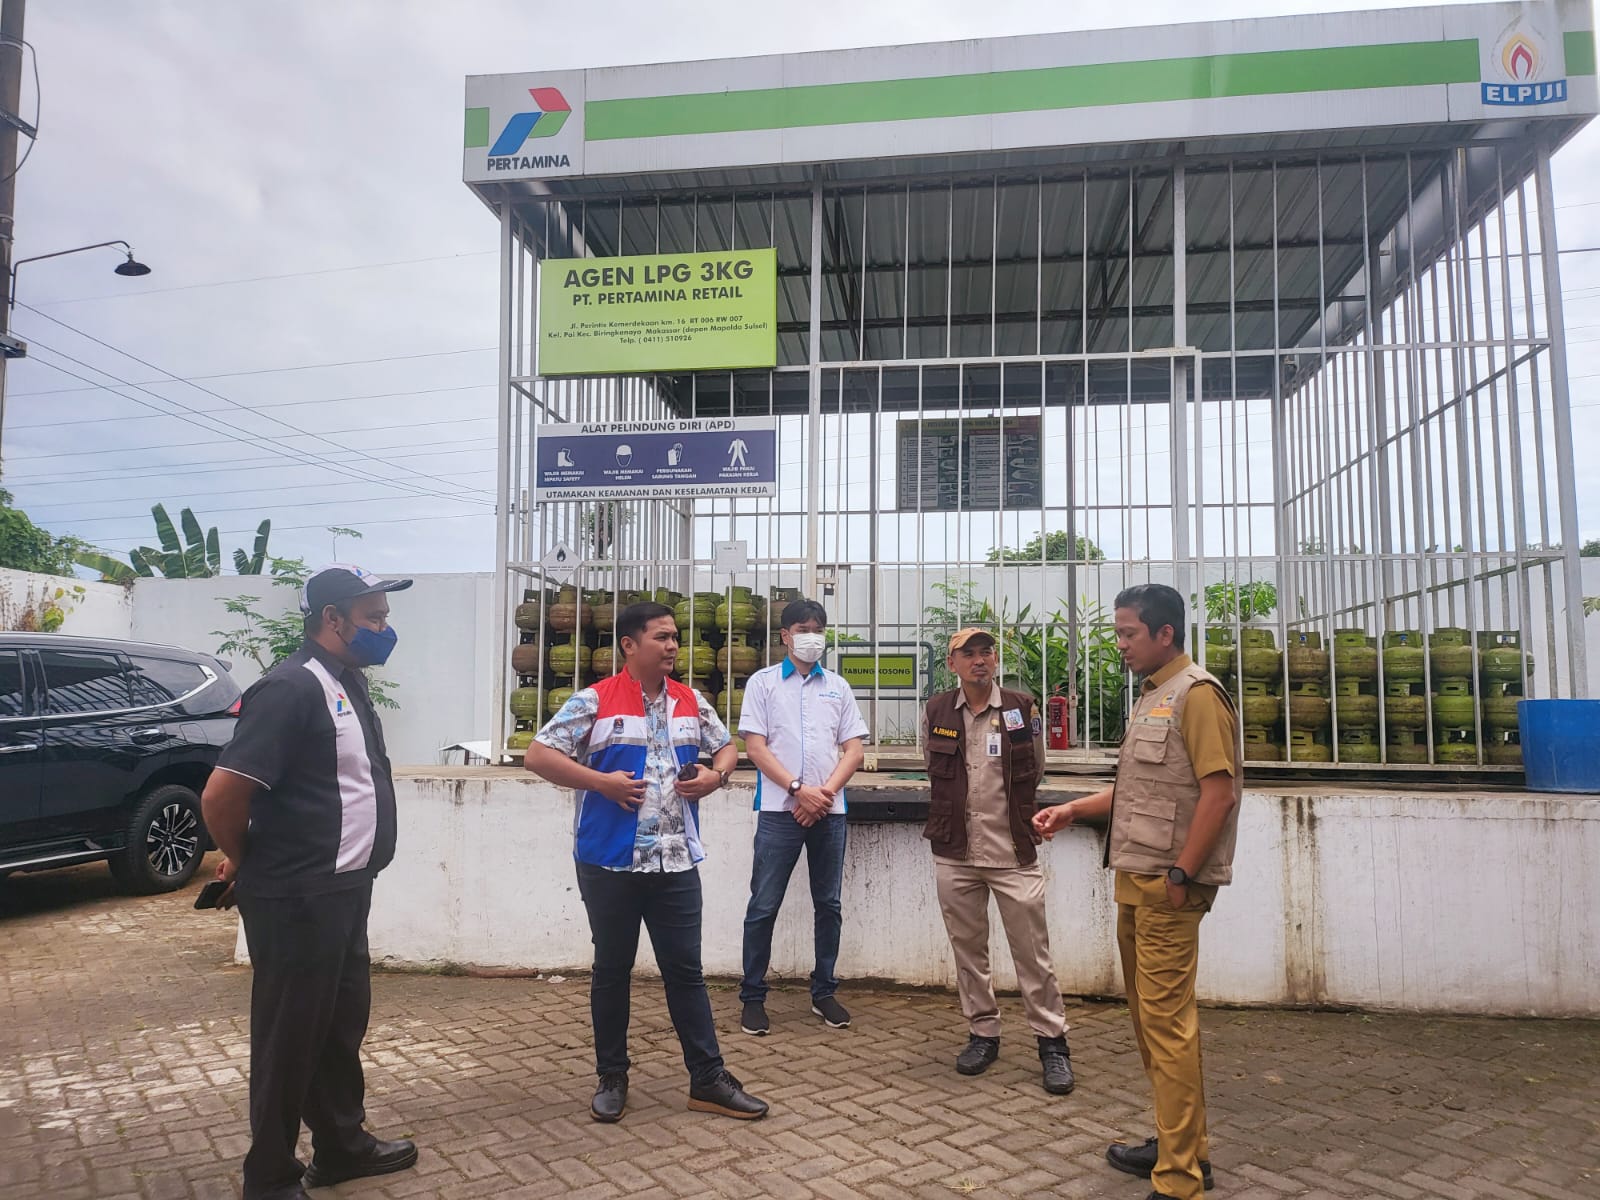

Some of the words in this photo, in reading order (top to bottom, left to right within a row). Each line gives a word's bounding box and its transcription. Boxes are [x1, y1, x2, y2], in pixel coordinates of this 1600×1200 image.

[1486, 83, 1562, 102] ELPIJI
[487, 155, 570, 171] PERTAMINA
[564, 266, 634, 288] AGEN
[644, 263, 692, 285] LPG
[701, 260, 754, 282] 3KG
[573, 294, 592, 306] PT.
[598, 289, 687, 305] PERTAMINA
[692, 286, 743, 300] RETAIL
[609, 320, 659, 328] Kemerdekaan
[682, 326, 708, 335] (depan
[710, 324, 742, 332] Mapolda
[581, 424, 607, 433] ALAT
[610, 422, 676, 432] PELINDUNG
[680, 421, 702, 431] DIRI
[705, 420, 736, 431] (APD)
[546, 490, 595, 498] UTAMAKAN
[599, 489, 650, 497] KEAMANAN
[653, 488, 672, 496] DAN
[675, 487, 738, 495] KESELAMATAN
[741, 486, 768, 494] KERJA
